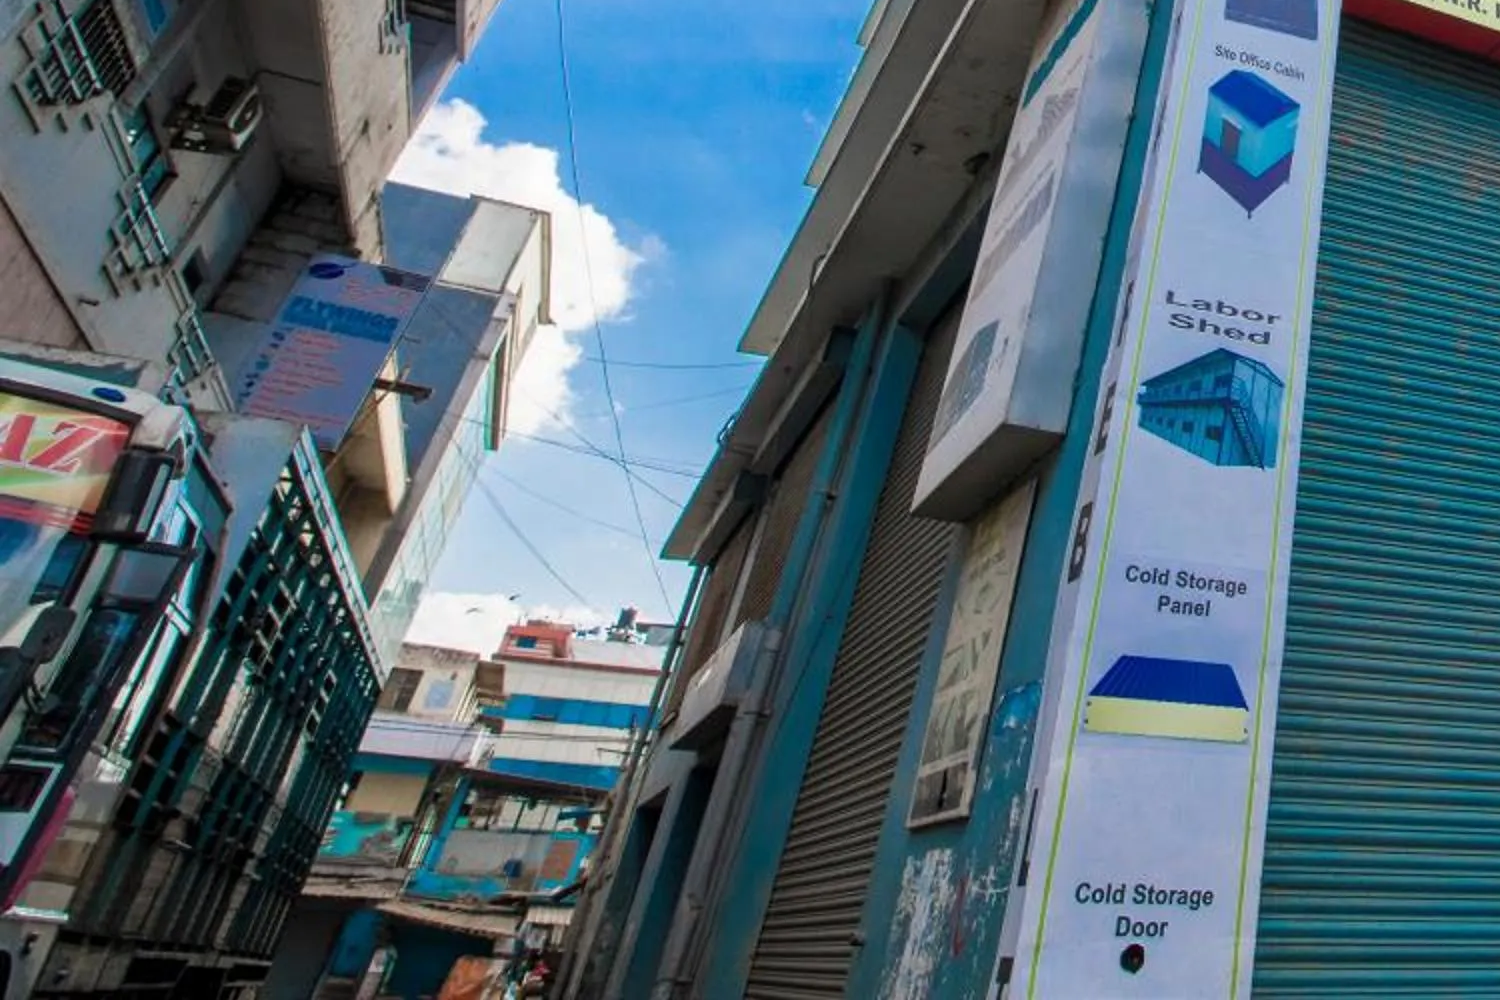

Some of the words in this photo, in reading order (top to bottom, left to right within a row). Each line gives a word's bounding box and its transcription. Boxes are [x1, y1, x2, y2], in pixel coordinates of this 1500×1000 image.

[1214, 44, 1237, 63] Site
[1239, 50, 1272, 72] Office
[1273, 60, 1306, 83] Cabin
[1166, 290, 1281, 326] Labor
[1168, 312, 1272, 346] Shed
[1125, 565, 1171, 588] Cold
[1175, 570, 1248, 597] Storage
[1157, 595, 1211, 617] Panel
[1075, 882, 1127, 905] Cold
[1132, 884, 1214, 911] Storage
[1115, 915, 1169, 937] Door
